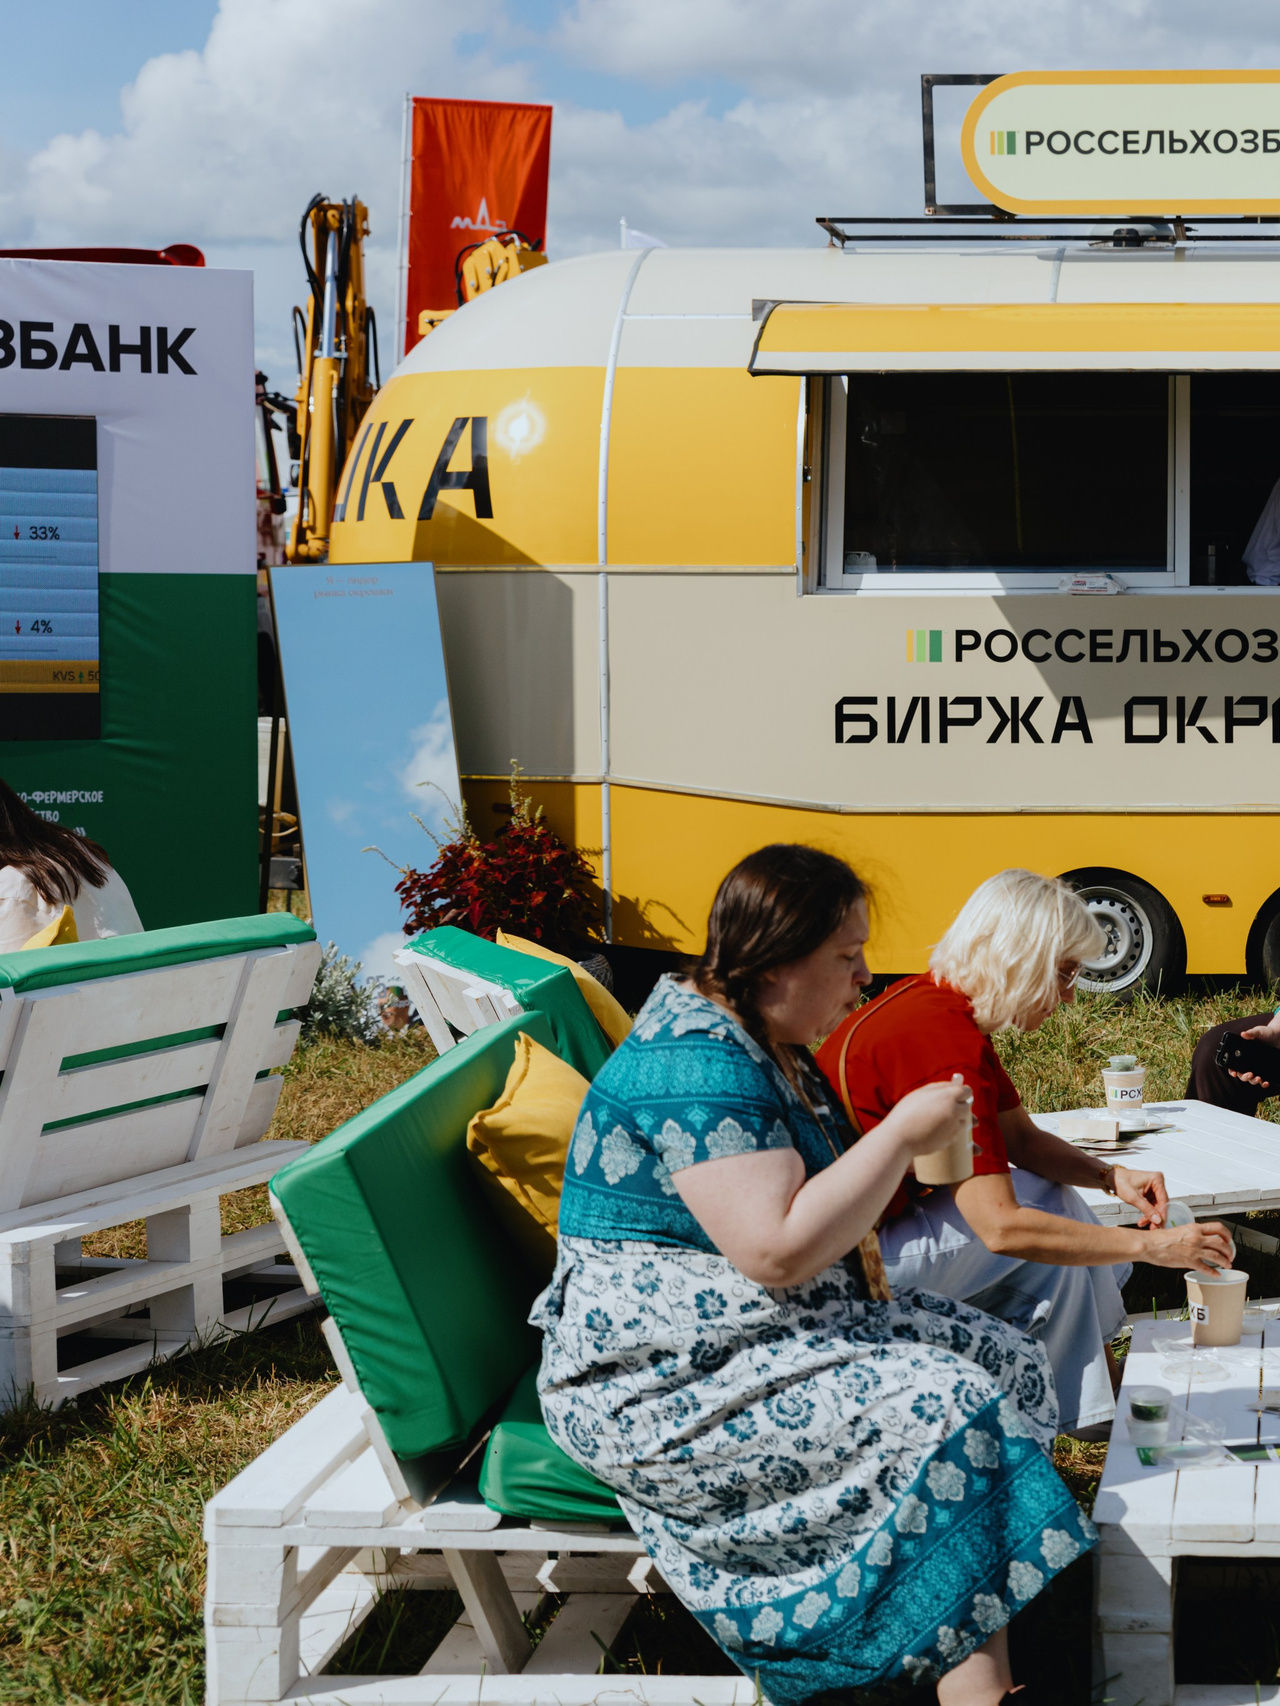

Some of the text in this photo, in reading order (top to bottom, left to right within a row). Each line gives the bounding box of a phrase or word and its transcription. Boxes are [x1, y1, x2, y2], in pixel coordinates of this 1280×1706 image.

[29, 525, 60, 541] 33%
[30, 619, 53, 634] 4%
[835, 695, 1094, 744] БИРЖА
[17, 790, 104, 803] О-ФЕРМЕРСКОЕ
[1120, 1087, 1143, 1099] РСХ
